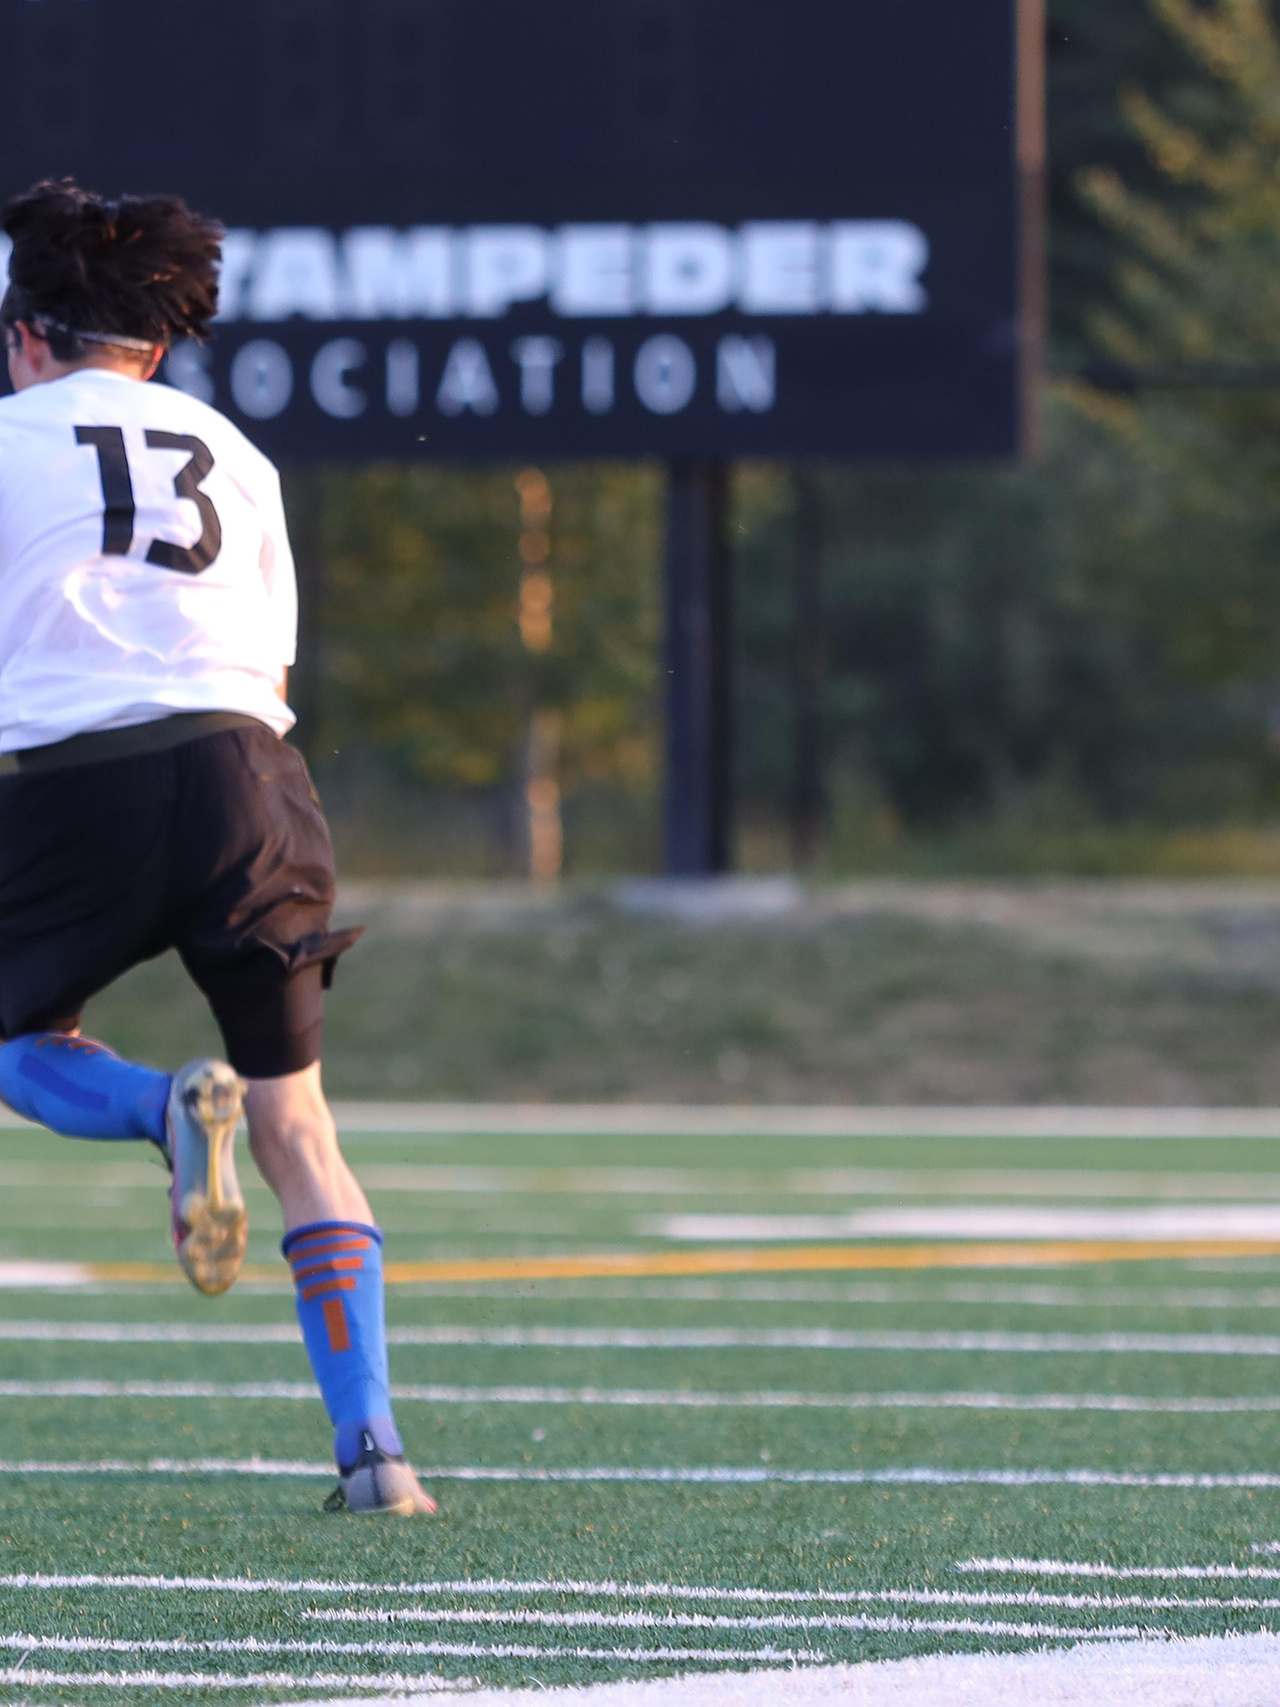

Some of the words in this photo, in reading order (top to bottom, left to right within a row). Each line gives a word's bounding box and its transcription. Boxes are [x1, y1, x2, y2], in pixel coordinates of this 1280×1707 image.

[213, 220, 927, 321] TAMPEDER
[166, 335, 776, 419] SOCIATION
[74, 425, 222, 576] 13
